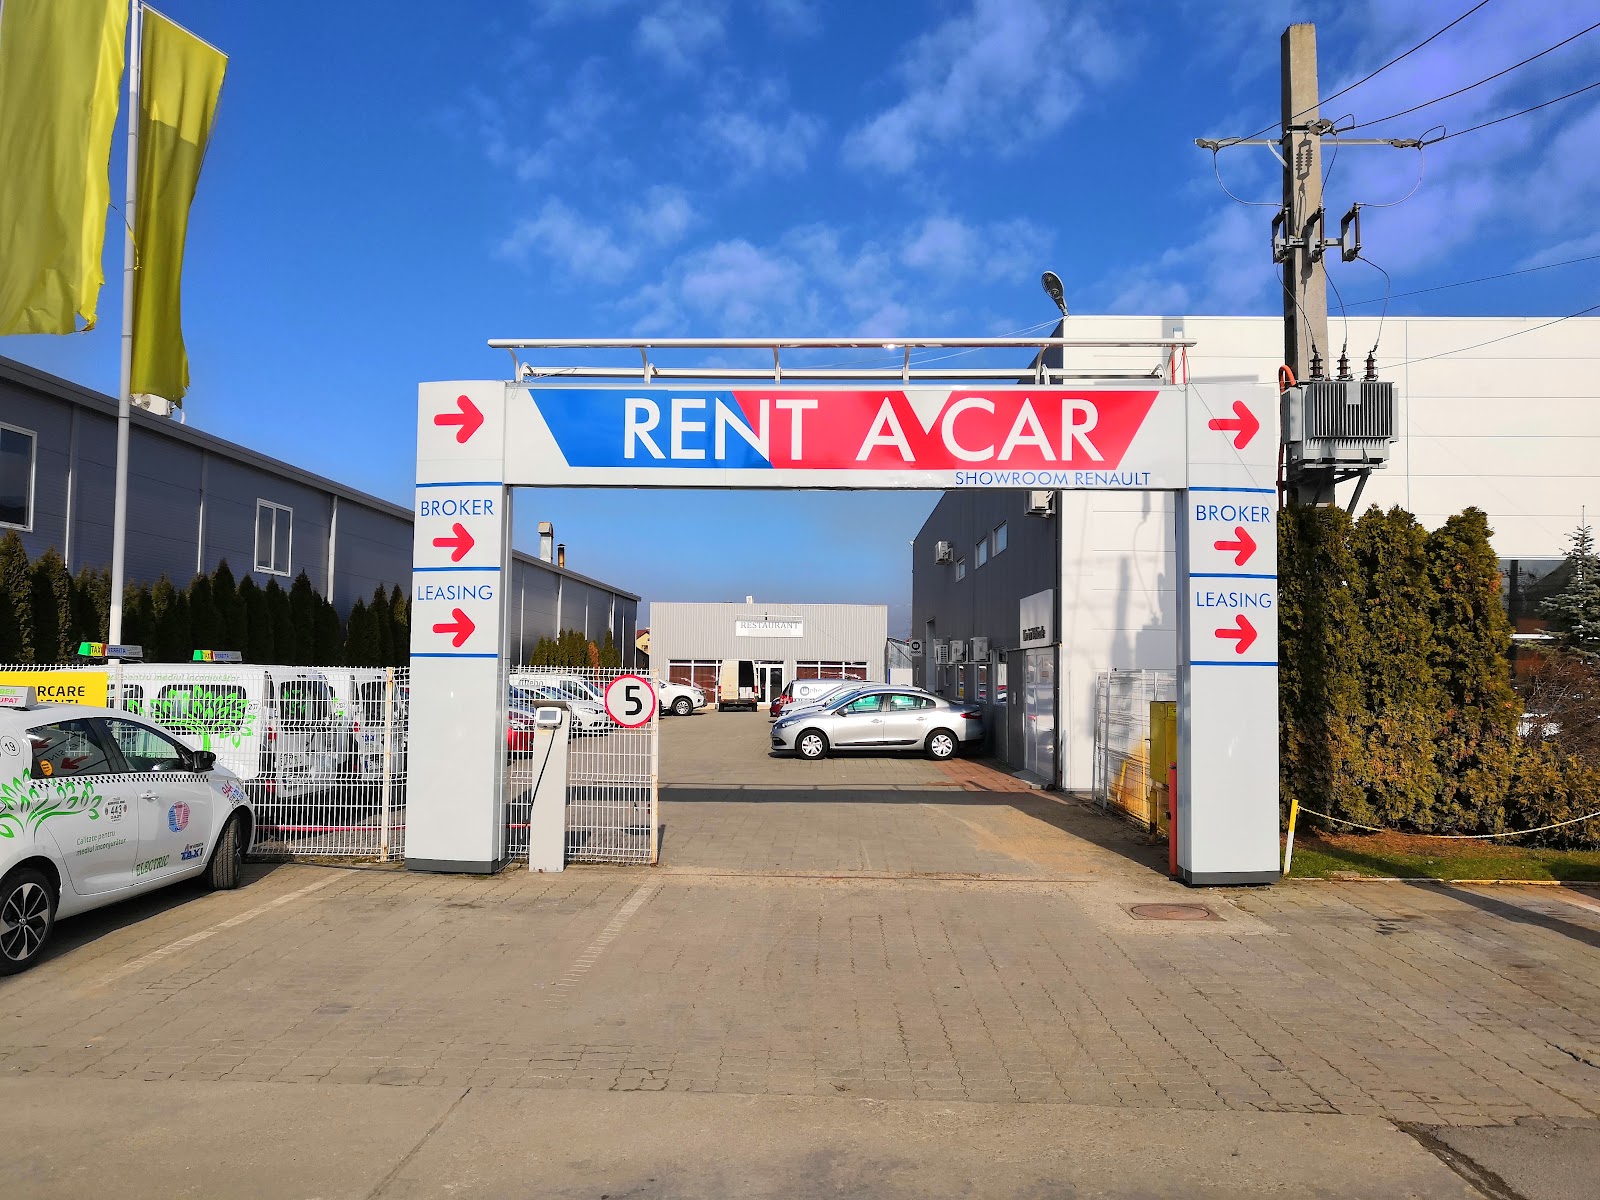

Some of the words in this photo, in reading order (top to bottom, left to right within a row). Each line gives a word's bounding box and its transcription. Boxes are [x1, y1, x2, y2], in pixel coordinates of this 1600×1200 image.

[623, 397, 819, 462] RENT
[855, 396, 916, 462] A
[940, 396, 1105, 462] CAR
[955, 470, 1068, 487] SHOWROOM
[1074, 471, 1151, 487] RENAULT
[420, 499, 494, 517] BROKER
[1195, 504, 1271, 523] BROKER
[417, 585, 493, 601] LEASING
[1196, 590, 1273, 609] LEASING
[740, 621, 799, 629] RESTAURANT
[624, 685, 643, 716] 5
[4, 740, 16, 752] 19
[110, 803, 122, 816] 443
[76, 835, 98, 846] Calitate
[97, 830, 116, 842] pentru
[180, 847, 204, 861] TAXI
[136, 854, 170, 877] ELECTRIC
